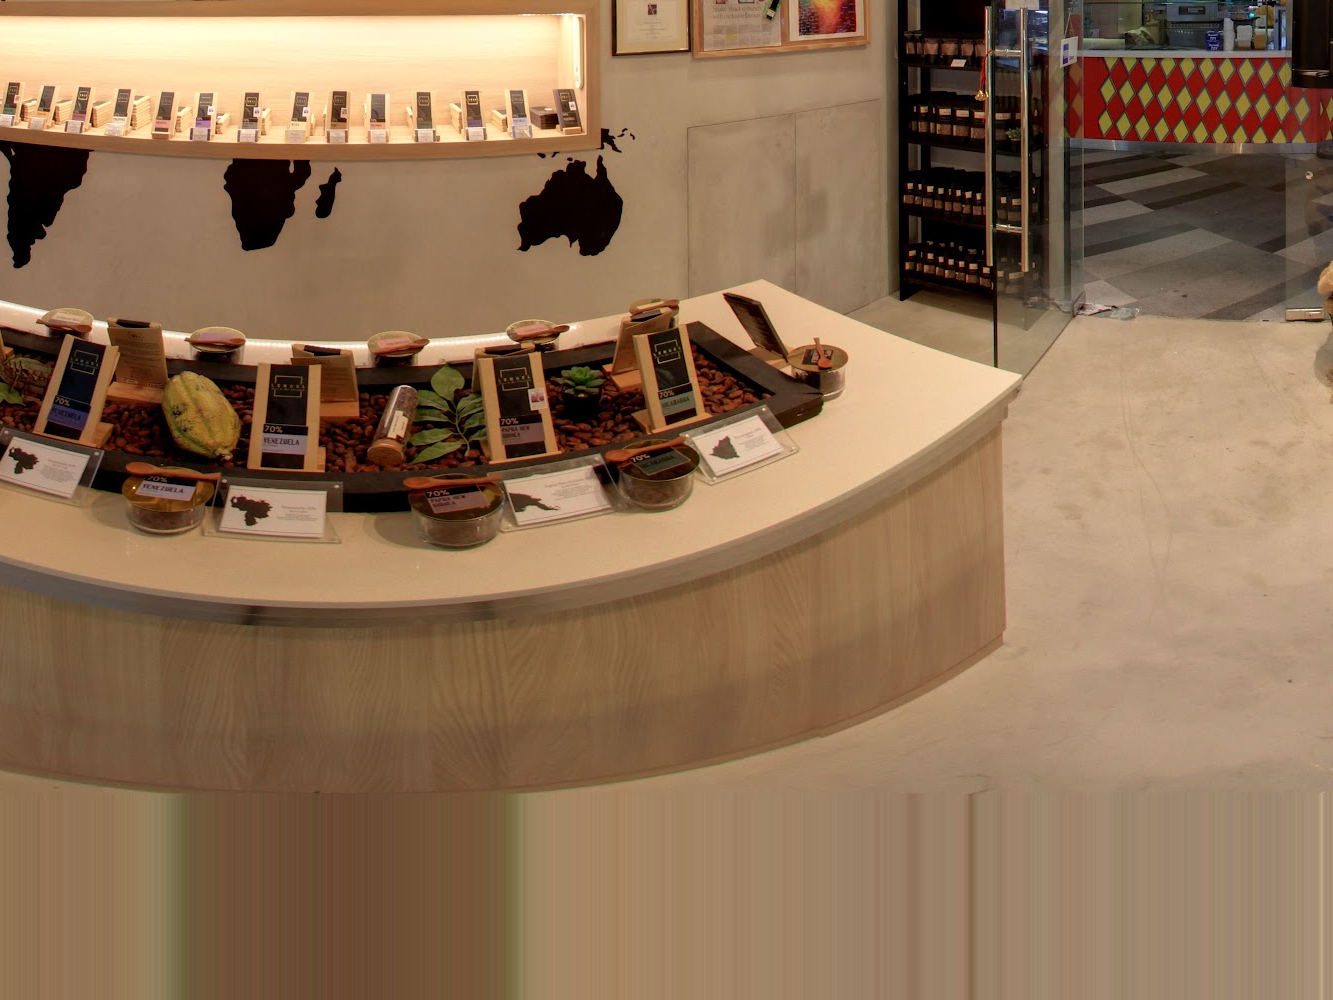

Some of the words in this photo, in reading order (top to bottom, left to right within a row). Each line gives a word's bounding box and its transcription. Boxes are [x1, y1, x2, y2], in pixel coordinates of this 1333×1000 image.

[659, 390, 674, 399] 70%
[54, 396, 70, 407] 70%
[501, 418, 519, 426] 70%
[265, 425, 283, 433] 70%
[263, 437, 300, 446] VENEZUELA
[630, 454, 651, 463] 70%
[147, 475, 168, 483] 70%
[142, 483, 184, 494] VENEZUELA
[426, 489, 450, 498] 70%
